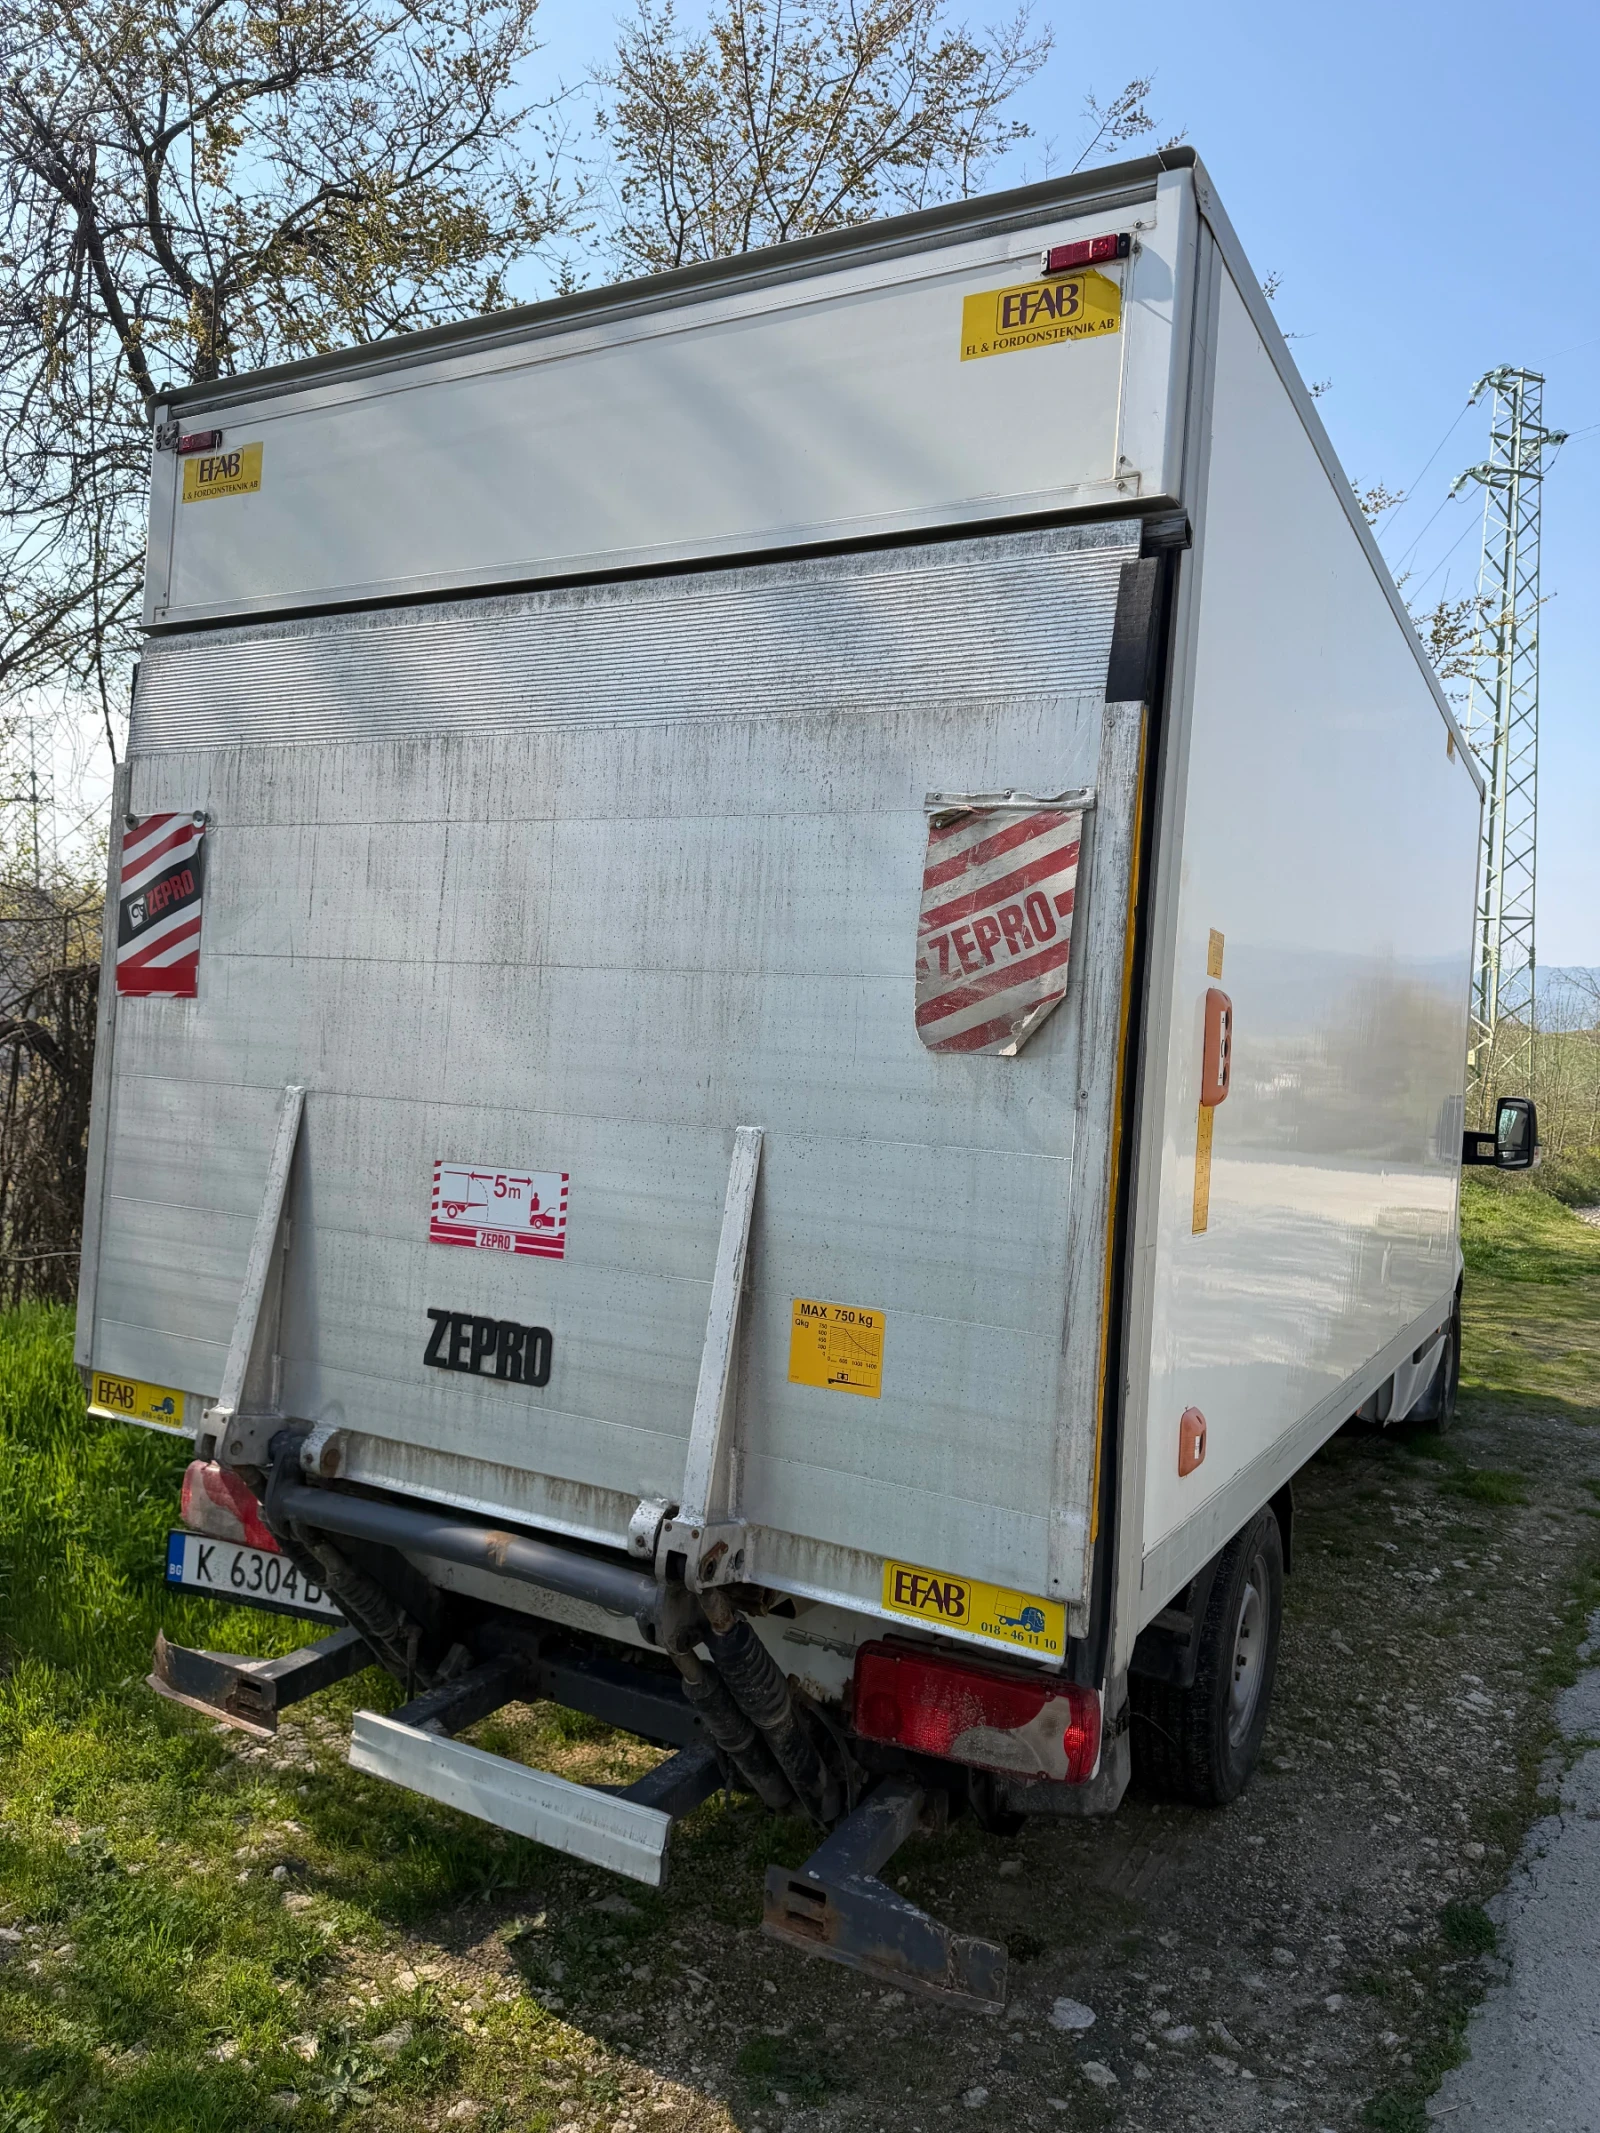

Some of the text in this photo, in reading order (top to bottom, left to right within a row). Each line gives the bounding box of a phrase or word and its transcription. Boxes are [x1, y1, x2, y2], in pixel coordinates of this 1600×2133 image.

[1002, 283, 1079, 329] EFAB
[966, 318, 1115, 356] EL & FORDONSTEKNIK AB
[199, 452, 241, 483] EFAB
[194, 483, 248, 498] FORDONSTEKNIK
[249, 480, 258, 489] AB
[146, 869, 195, 916] ZEPRO
[926, 890, 1057, 981] ZEPRO
[480, 1232, 511, 1250] ZEPRO
[795, 1318, 809, 1328] Qkg
[801, 1303, 873, 1328] MAX 750 kg
[423, 1308, 553, 1388] ZEPRO
[98, 1379, 134, 1409] EFAB
[169, 1563, 182, 1576] BG
[196, 1544, 216, 1582] K
[894, 1570, 965, 1618] EFAB
[981, 1621, 1000, 1635] 018
[1010, 1628, 1024, 1642] 46
[1027, 1631, 1039, 1646] 11
[1044, 1638, 1057, 1650] 10
